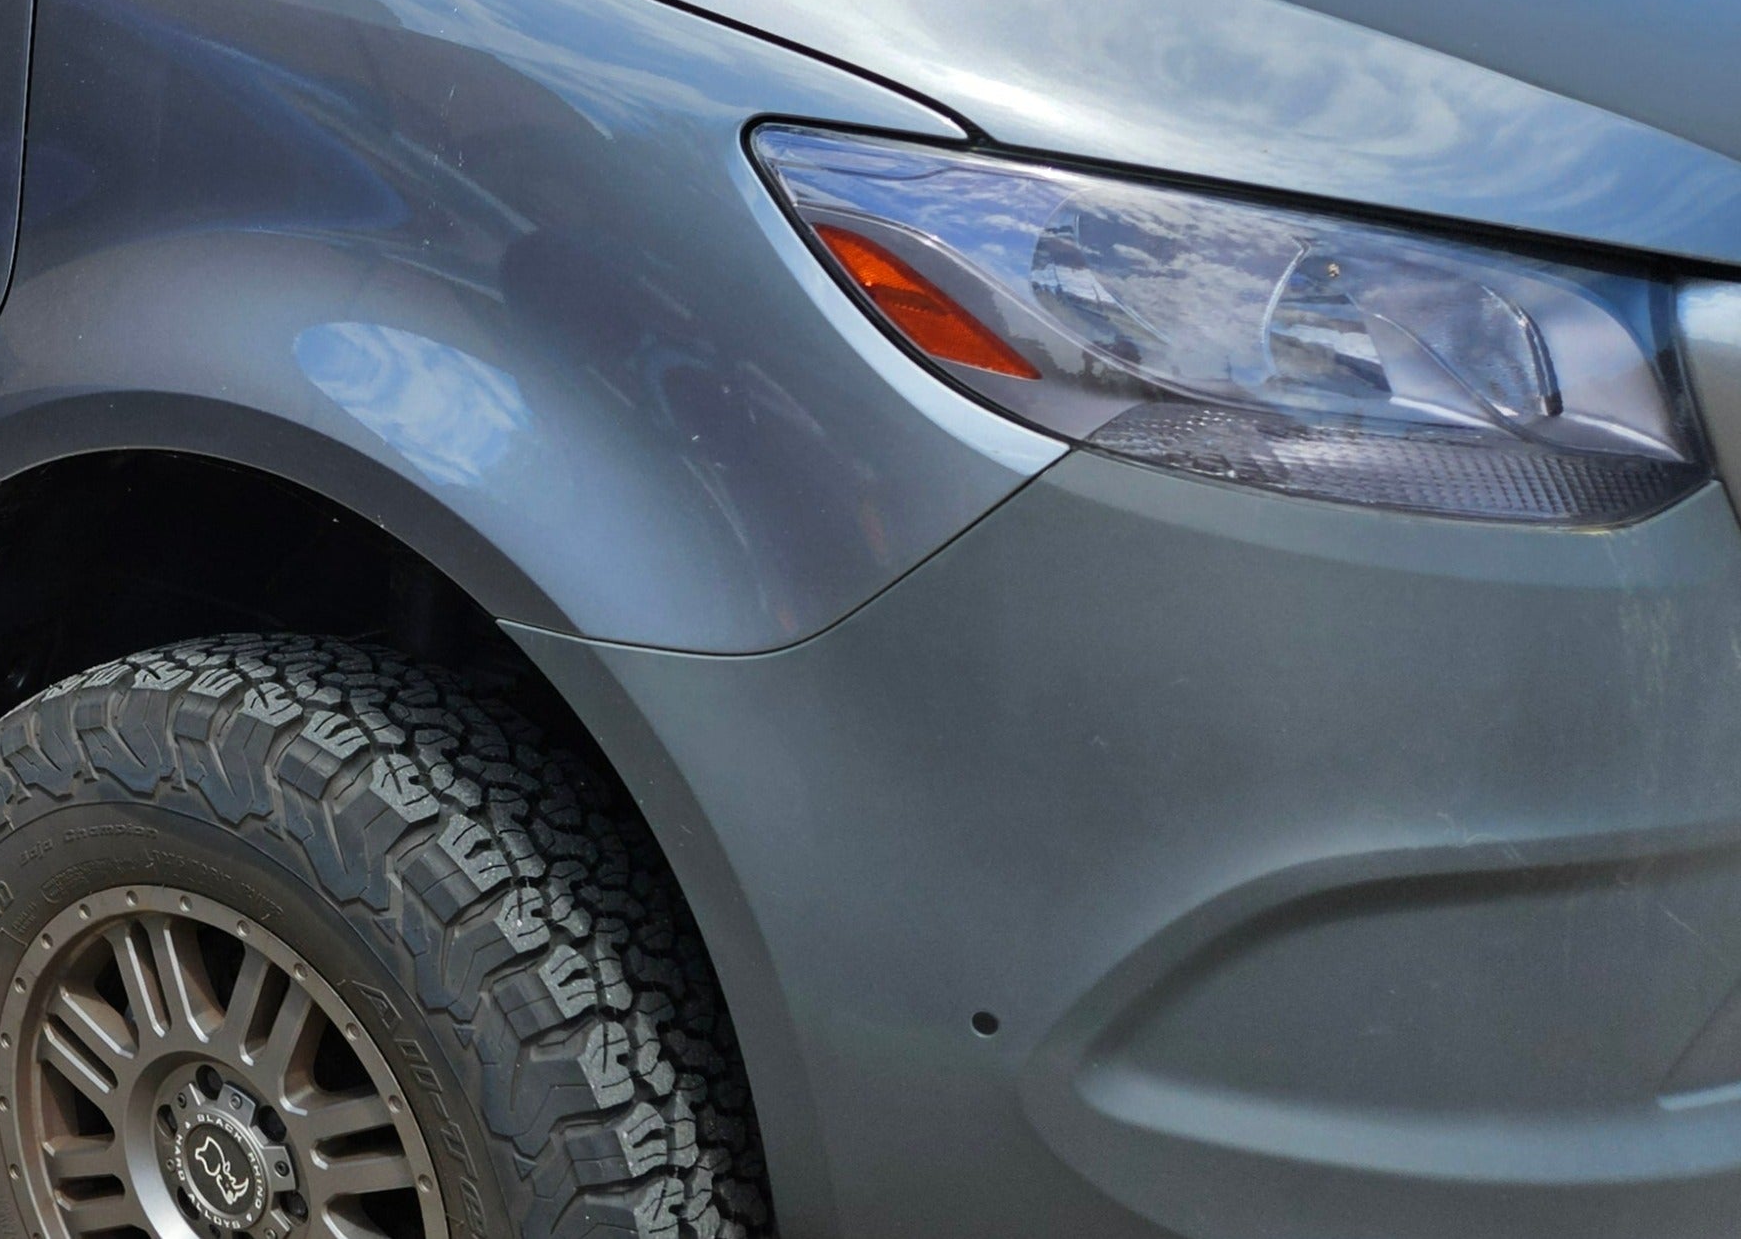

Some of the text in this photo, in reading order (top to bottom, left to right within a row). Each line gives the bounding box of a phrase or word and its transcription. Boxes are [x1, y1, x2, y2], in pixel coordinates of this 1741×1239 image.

[174, 1134, 241, 1229] HARD ALLOYS
[196, 1113, 263, 1209] BLACK RHINO
